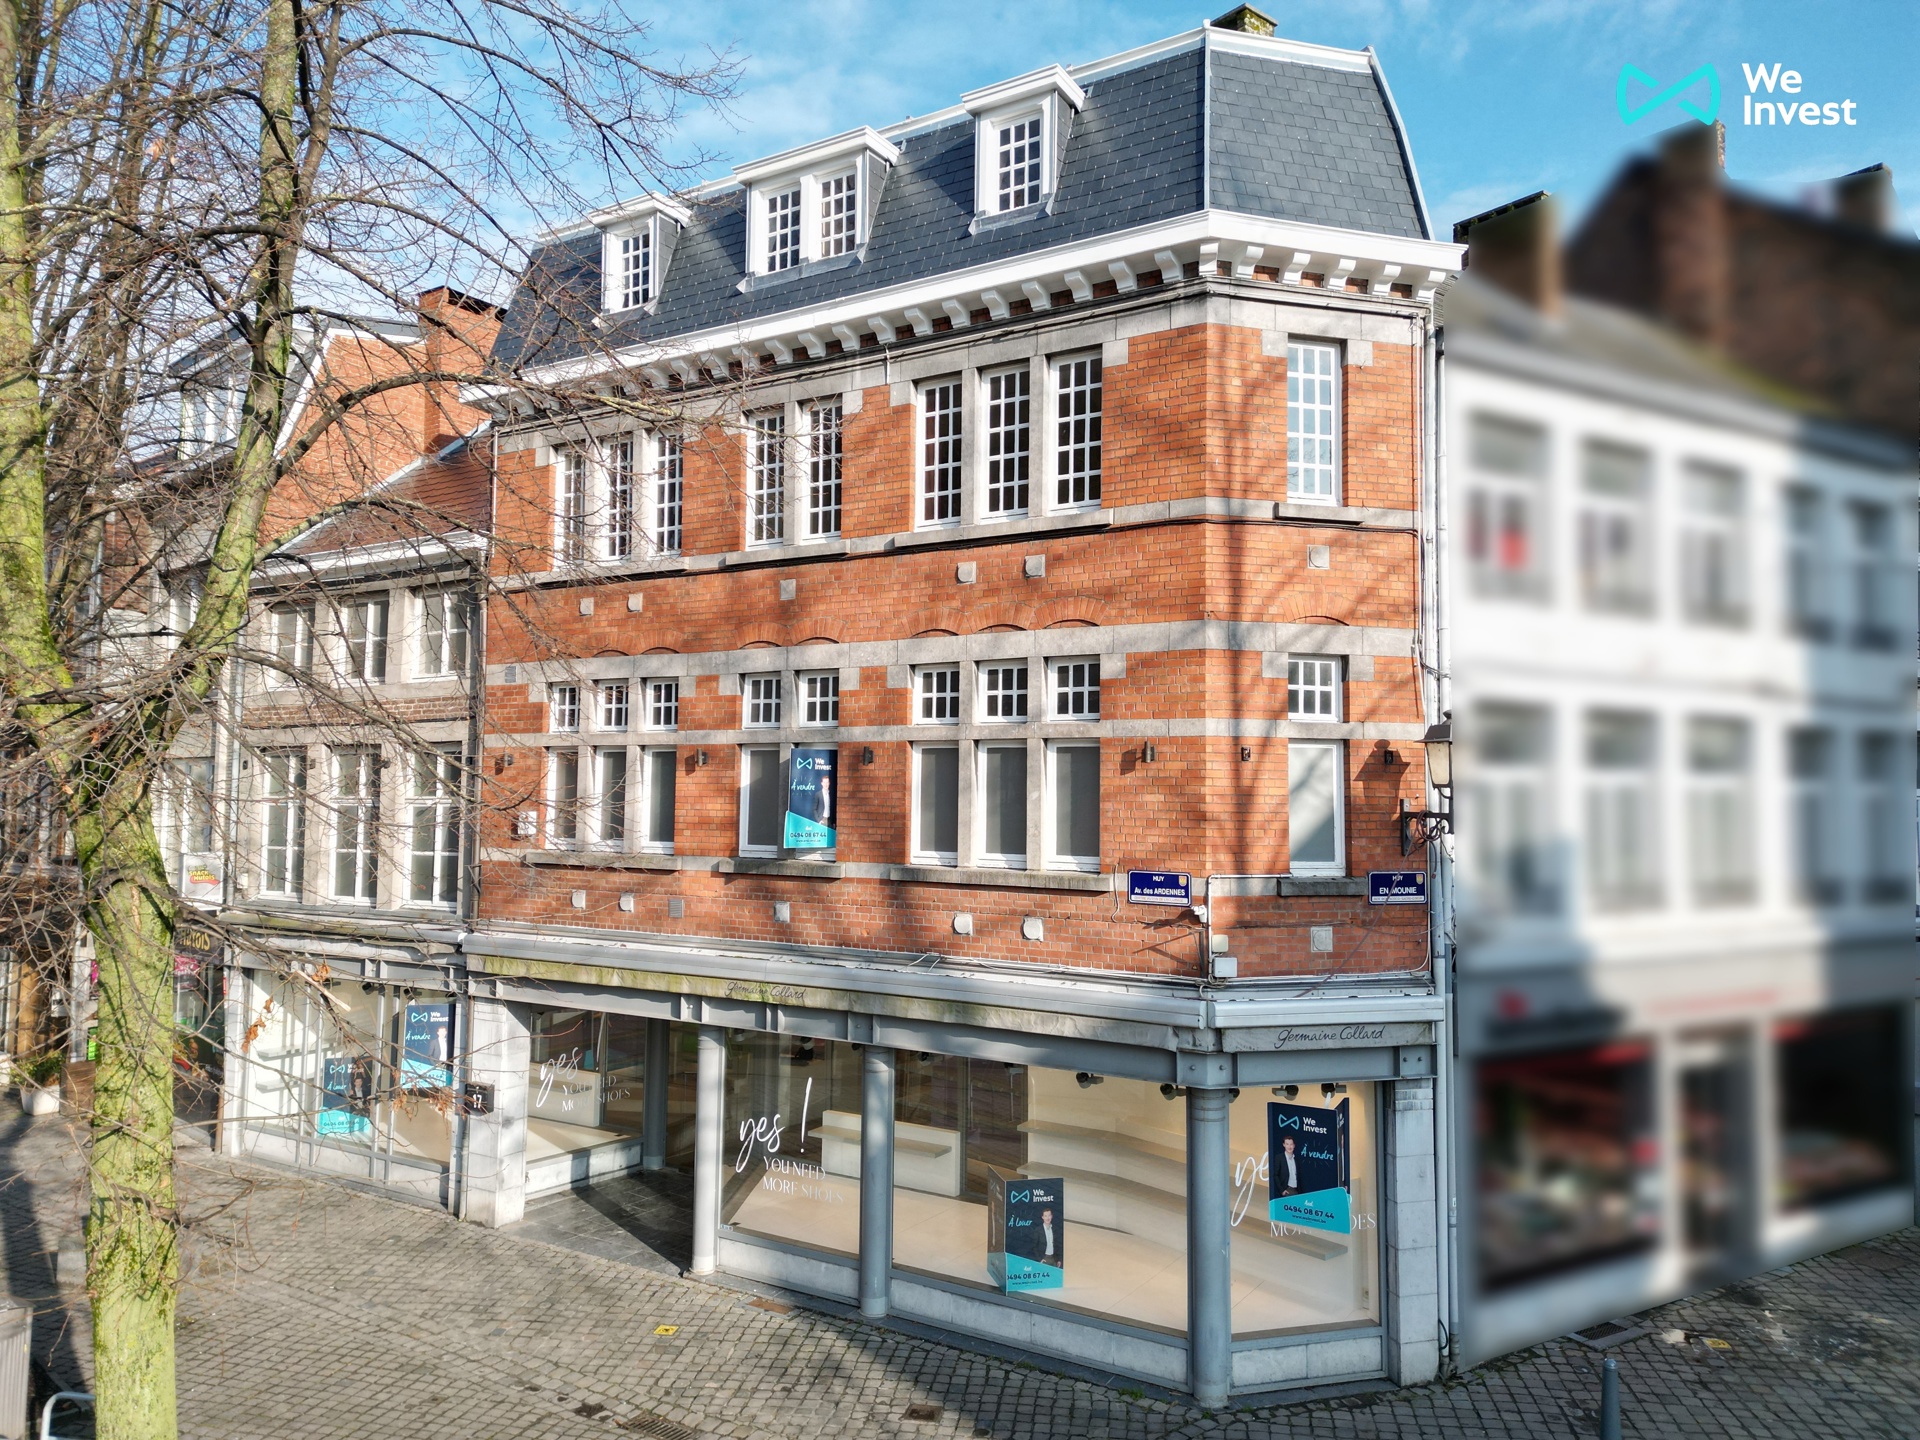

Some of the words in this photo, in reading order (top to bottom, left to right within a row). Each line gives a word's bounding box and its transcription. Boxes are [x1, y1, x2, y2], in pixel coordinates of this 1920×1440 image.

[1153, 888, 1186, 896] ARDENNES
[1391, 886, 1417, 894] MOUNIE
[1339, 1025, 1385, 1040] Collard
[535, 1046, 583, 1108] yes
[472, 1093, 482, 1109] 17
[735, 1113, 786, 1173] yes
[800, 1076, 813, 1153] !
[1303, 1116, 1316, 1125] We
[1303, 1124, 1328, 1134] Invest
[1308, 1149, 1334, 1161] vendre
[763, 1156, 790, 1174] YOU
[792, 1160, 826, 1181] NEED
[762, 1175, 798, 1196] MORE
[1230, 1151, 1269, 1227] ye
[1032, 1195, 1054, 1203] Invest
[1283, 1204, 1302, 1214] 0494
[1303, 1207, 1313, 1216] 08
[1314, 1210, 1323, 1218] 67
[1324, 1212, 1335, 1220] 44
